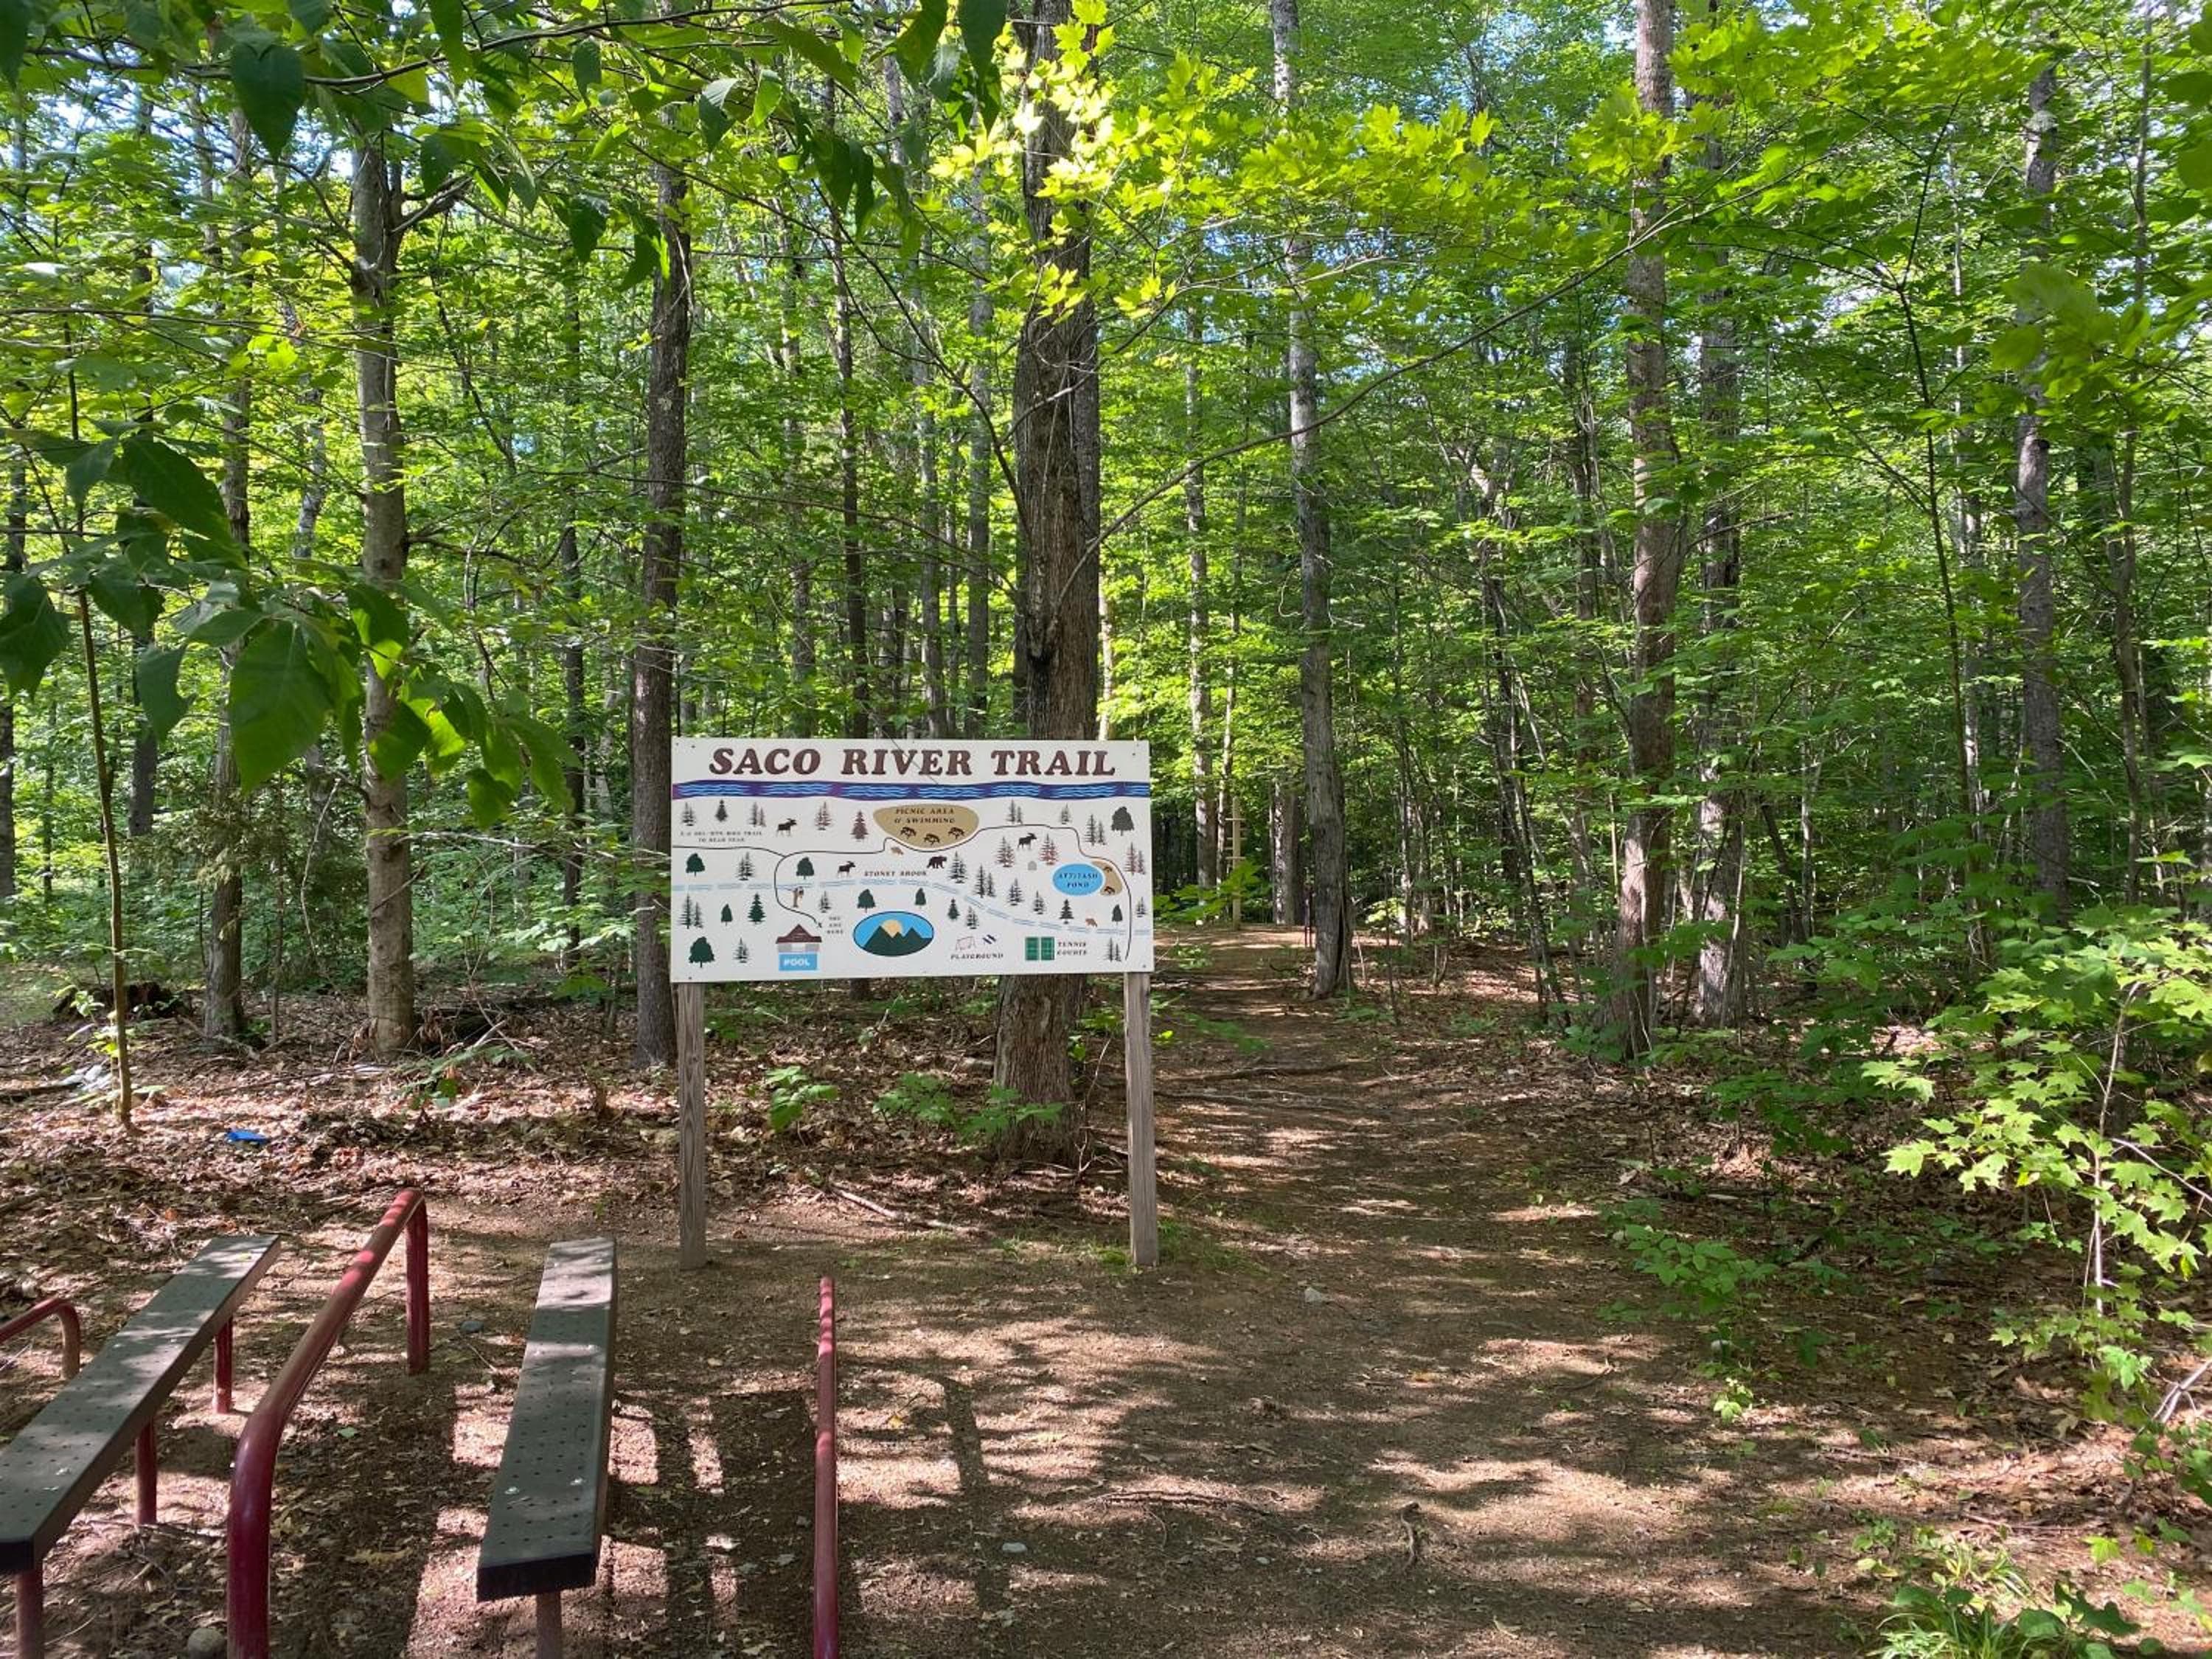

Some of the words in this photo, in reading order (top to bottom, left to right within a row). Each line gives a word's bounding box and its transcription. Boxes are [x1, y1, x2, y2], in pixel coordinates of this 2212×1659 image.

[709, 748, 821, 775] SACO
[841, 748, 973, 776] RIVER
[990, 749, 1116, 776] TRAIL
[783, 958, 810, 967] POOL
